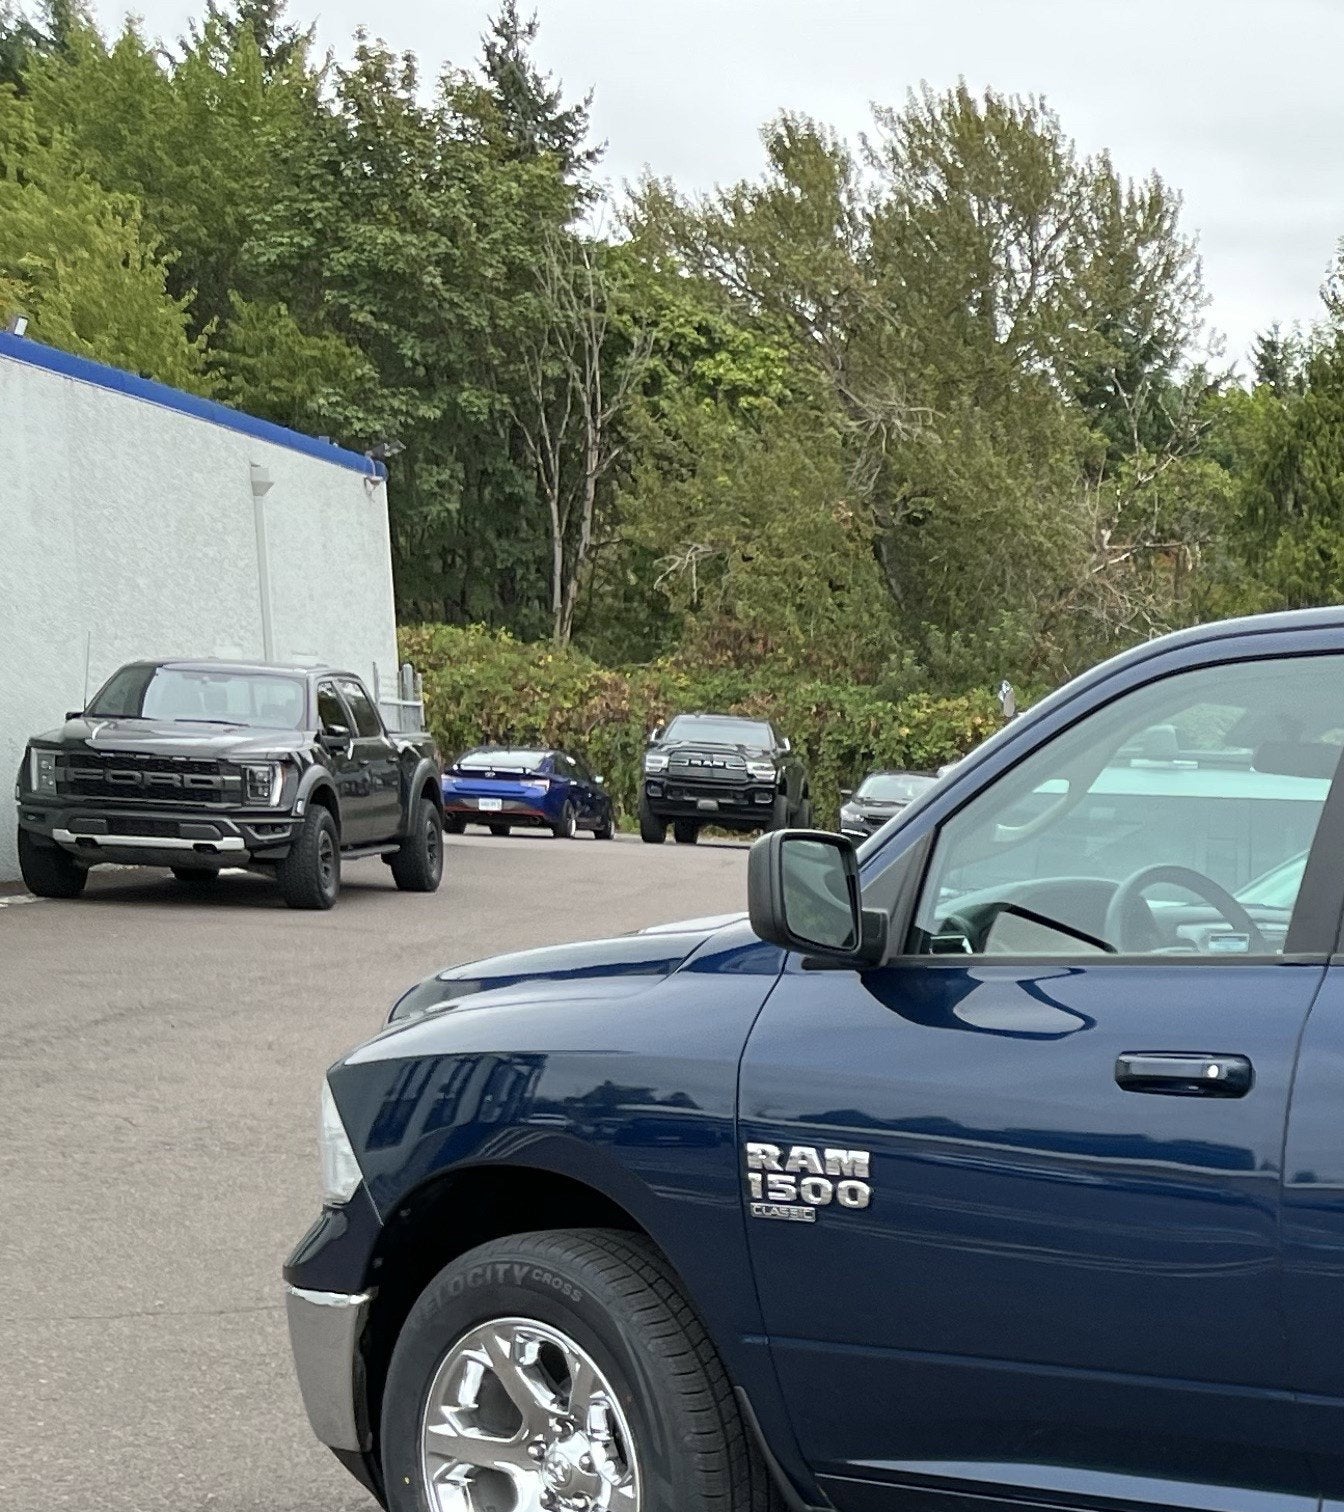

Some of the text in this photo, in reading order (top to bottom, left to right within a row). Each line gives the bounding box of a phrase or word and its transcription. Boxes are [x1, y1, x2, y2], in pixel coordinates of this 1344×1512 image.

[63, 766, 226, 789] FORD
[747, 1142, 870, 1178] RAM
[748, 1172, 870, 1209] 1500
[532, 1268, 583, 1303] CROSS
